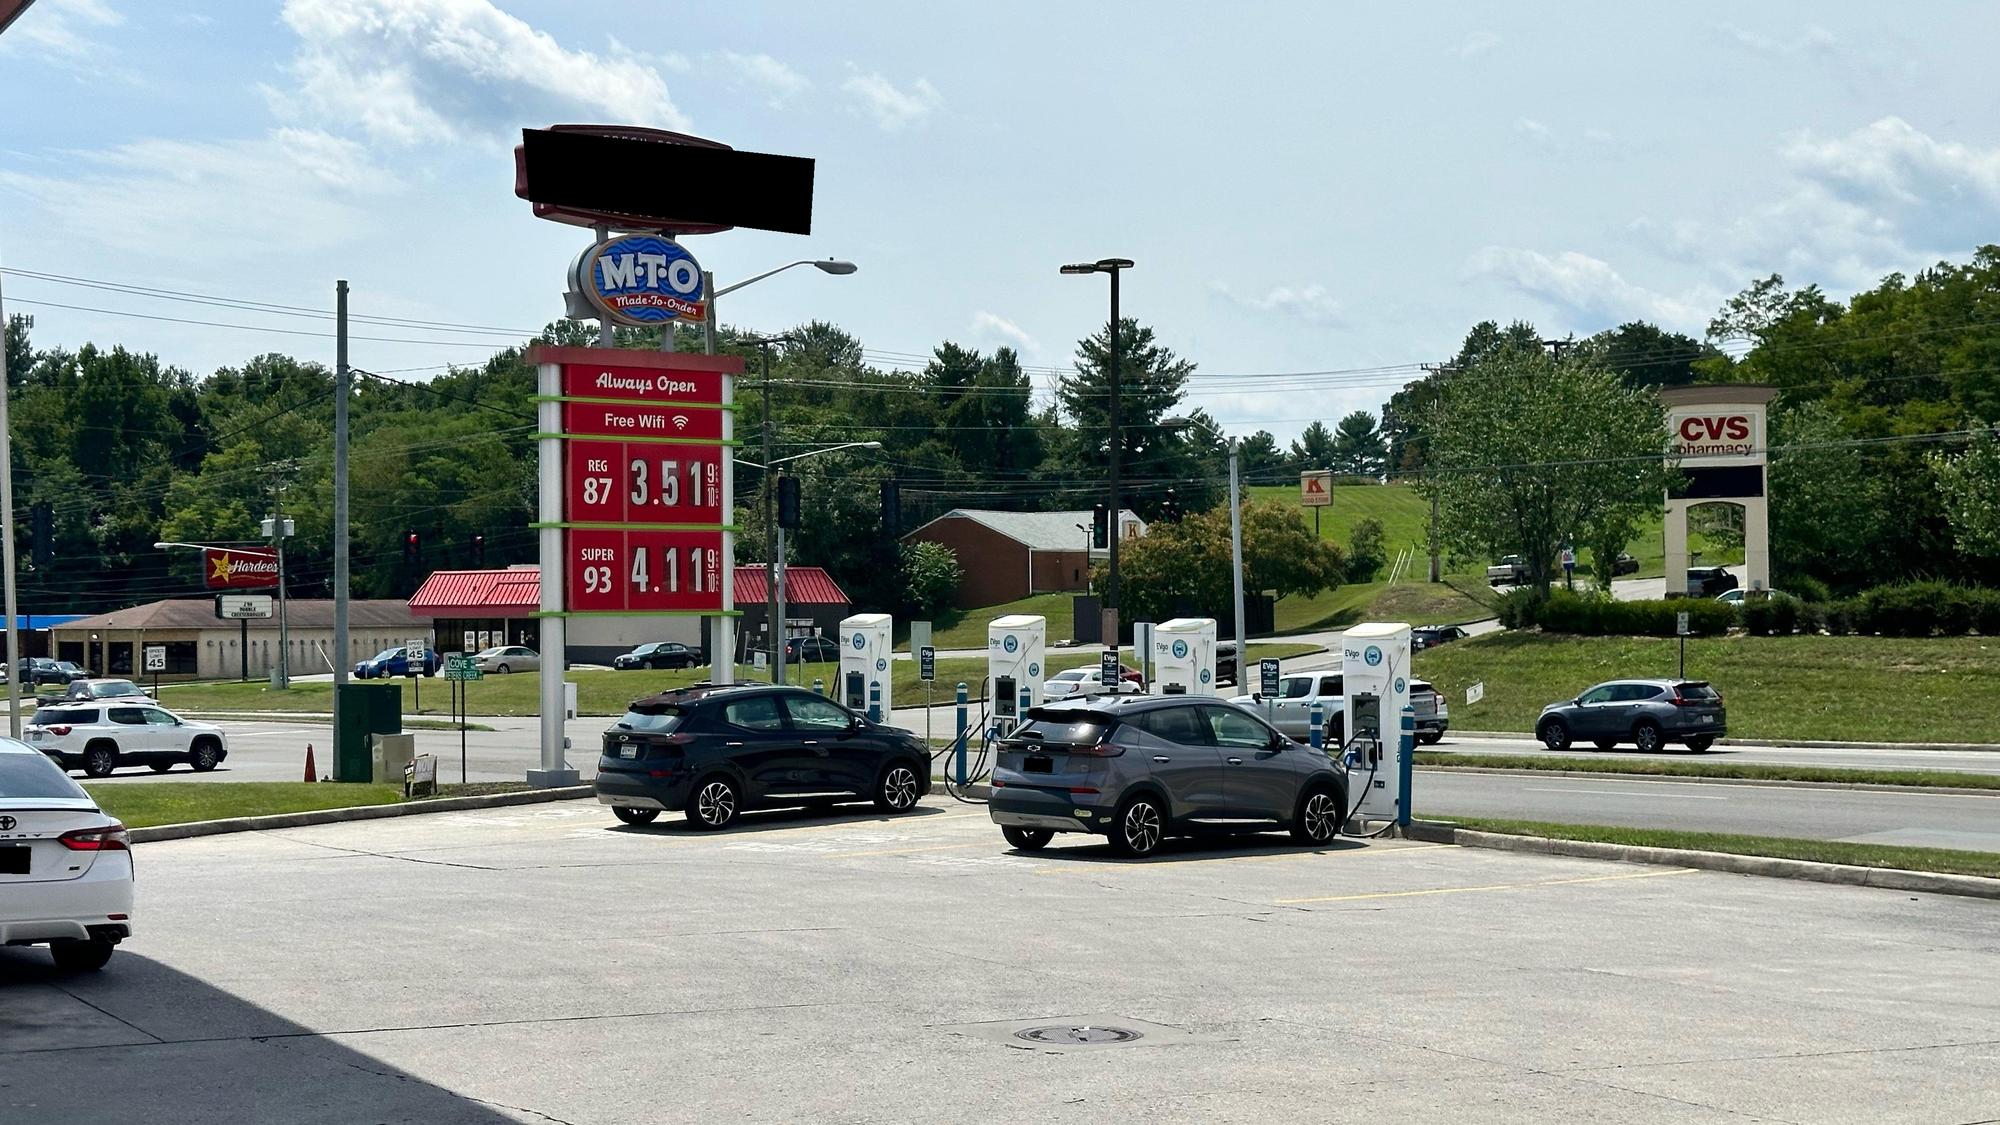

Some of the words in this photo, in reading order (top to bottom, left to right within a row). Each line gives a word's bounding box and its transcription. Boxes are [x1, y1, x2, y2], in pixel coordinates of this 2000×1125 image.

[596, 372, 653, 394] Always
[657, 376, 697, 396] Open
[605, 413, 635, 428] Free
[638, 414, 665, 429] Wifi
[1680, 416, 1749, 441] CVS
[588, 459, 608, 473] REG
[631, 459, 701, 506] 3.51
[583, 477, 613, 505] 87
[582, 548, 614, 561] SUPER
[229, 559, 278, 574] Hardee's
[631, 547, 702, 593] 4.11
[583, 566, 612, 593] 93
[408, 650, 424, 659] 45
[1345, 649, 1360, 659] EVgo
[148, 658, 164, 668] 45
[450, 658, 468, 669] COVE
[1262, 662, 1277, 672] EVgo
